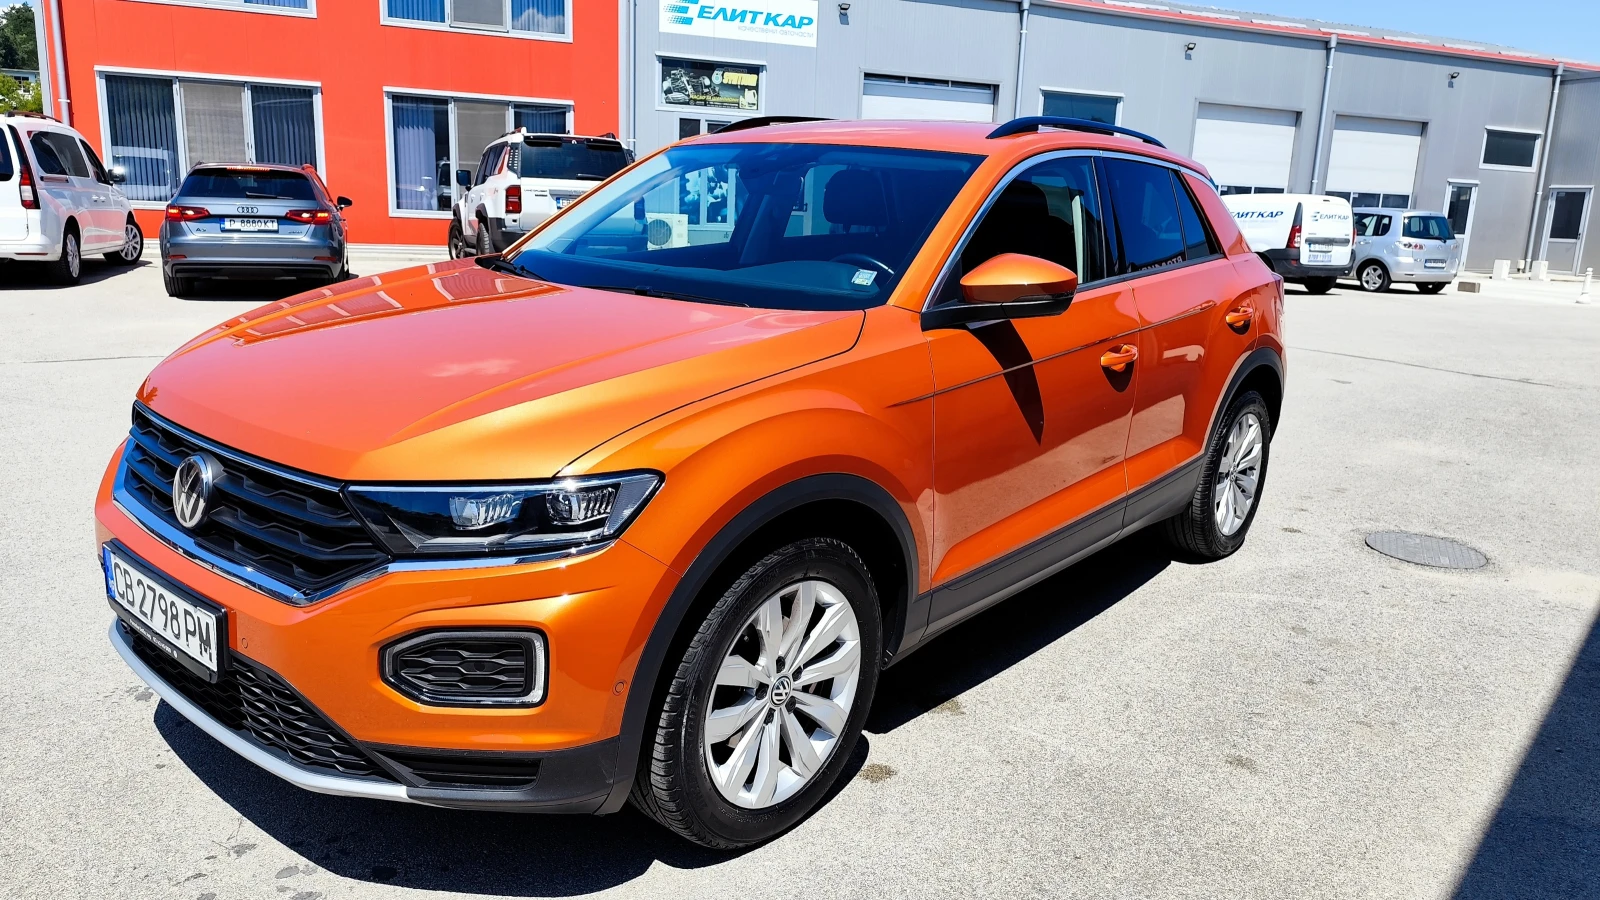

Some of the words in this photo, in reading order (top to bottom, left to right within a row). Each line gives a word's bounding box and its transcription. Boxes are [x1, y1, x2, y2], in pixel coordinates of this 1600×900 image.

[738, 25, 778, 35] качествени
[779, 29, 814, 38] авточасти
[1230, 211, 1257, 219] ЛИТ
[136, 579, 182, 640] 2798
